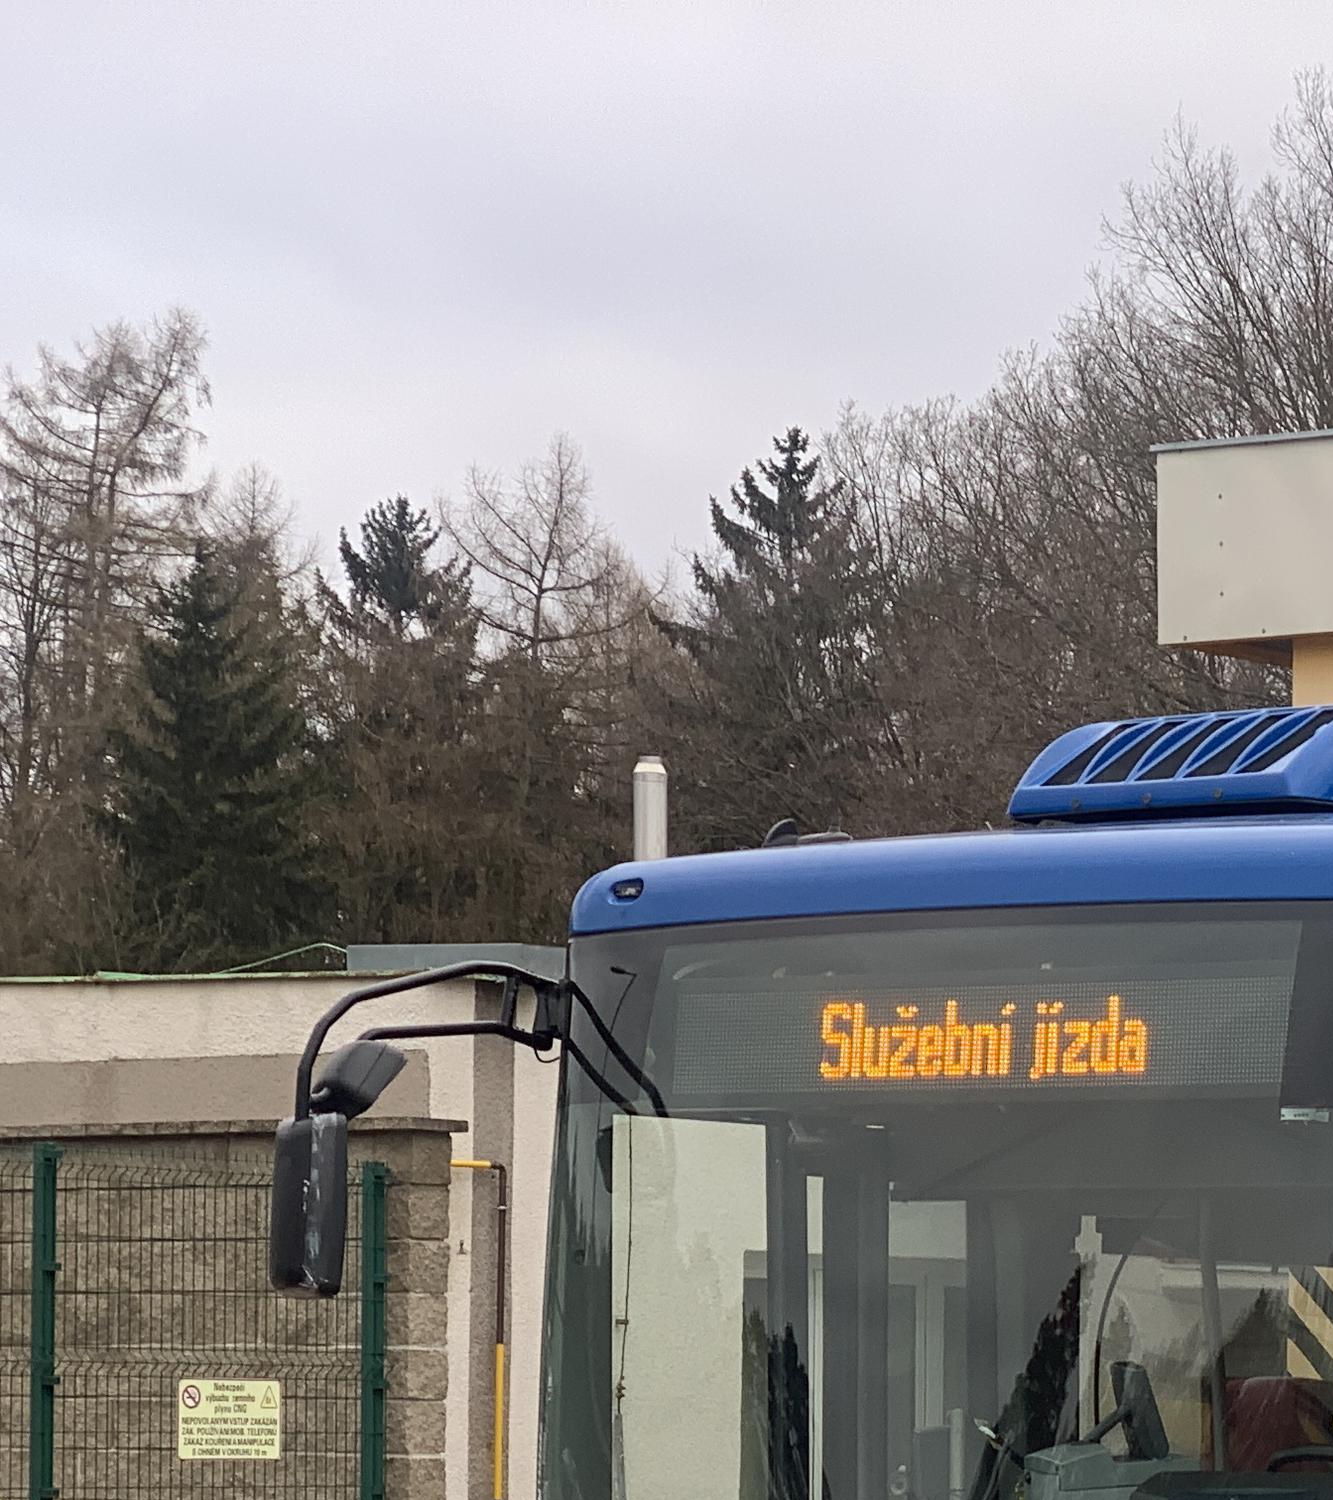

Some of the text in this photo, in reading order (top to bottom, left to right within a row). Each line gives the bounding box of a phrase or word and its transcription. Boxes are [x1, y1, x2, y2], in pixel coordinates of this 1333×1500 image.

[820, 994, 1148, 1080] Služební jízda
[214, 1403, 247, 1414] plynu CNG
[230, 1416, 249, 1425] VSTUP
[226, 1448, 252, 1456] OKRUHU
